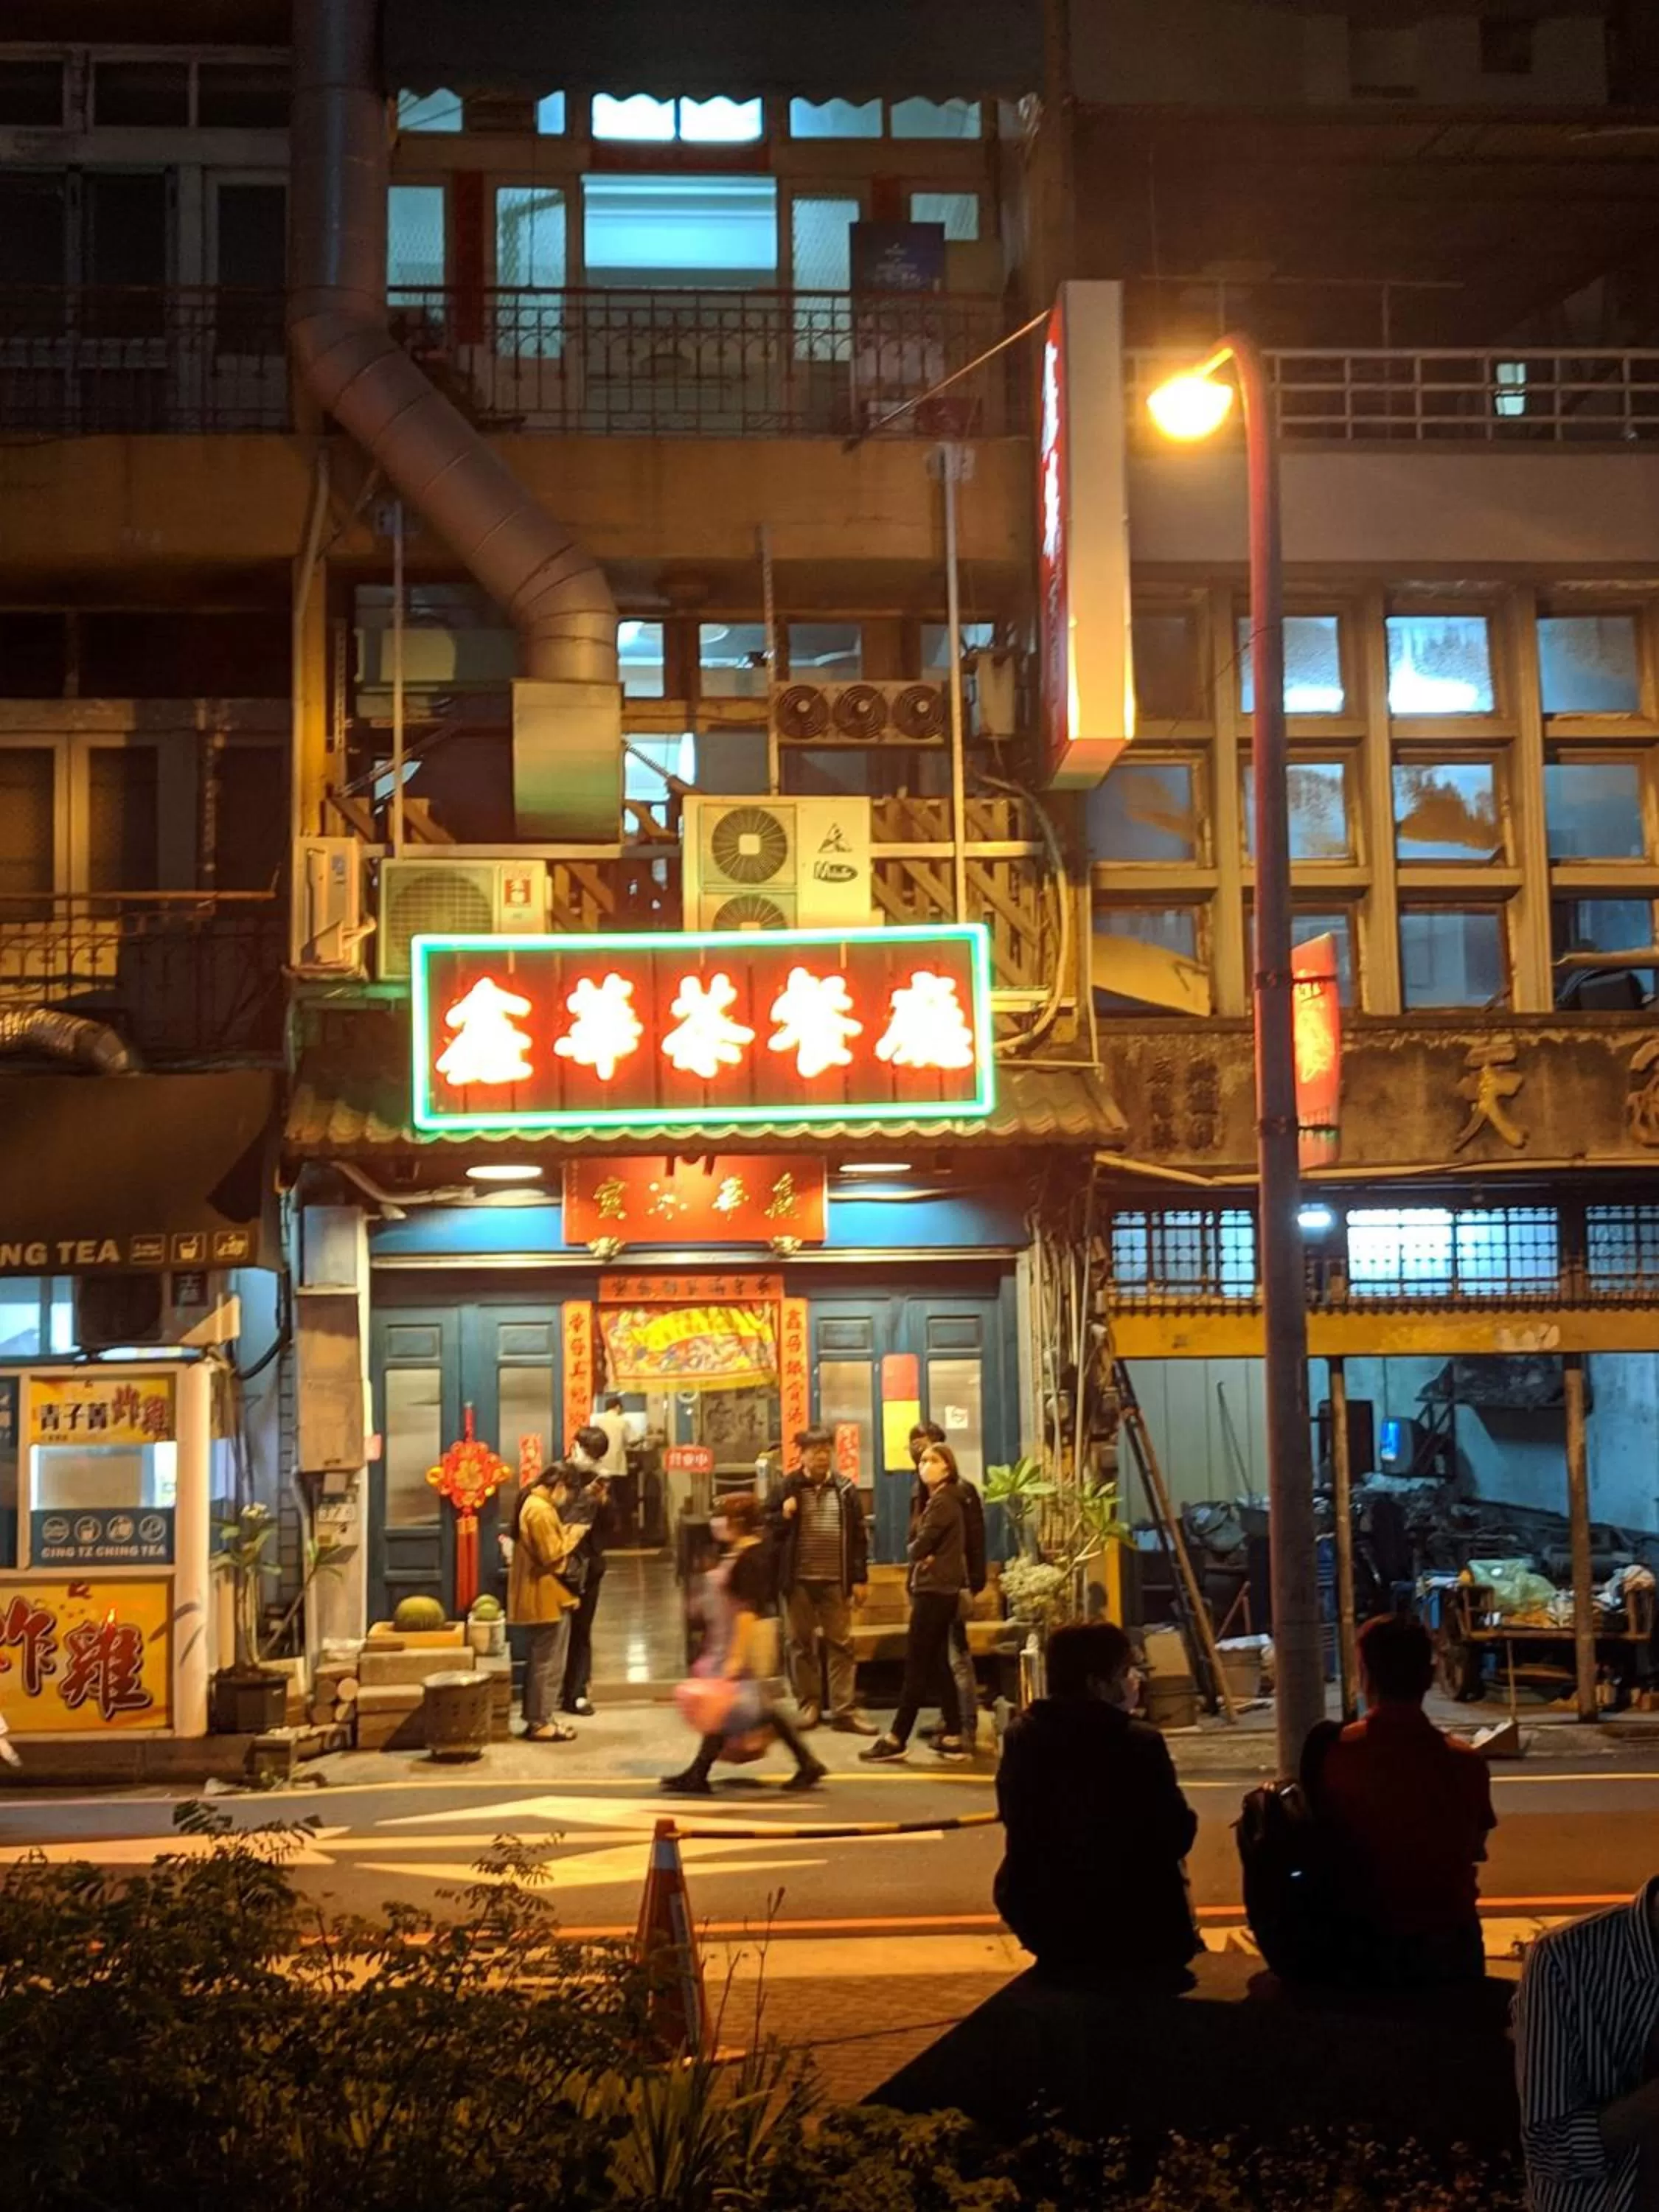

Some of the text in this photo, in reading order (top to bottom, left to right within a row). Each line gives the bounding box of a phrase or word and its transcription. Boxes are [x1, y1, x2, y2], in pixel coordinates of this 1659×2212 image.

[0, 1239, 120, 1267] NG TEA
[140, 1545, 166, 1557] TEA
